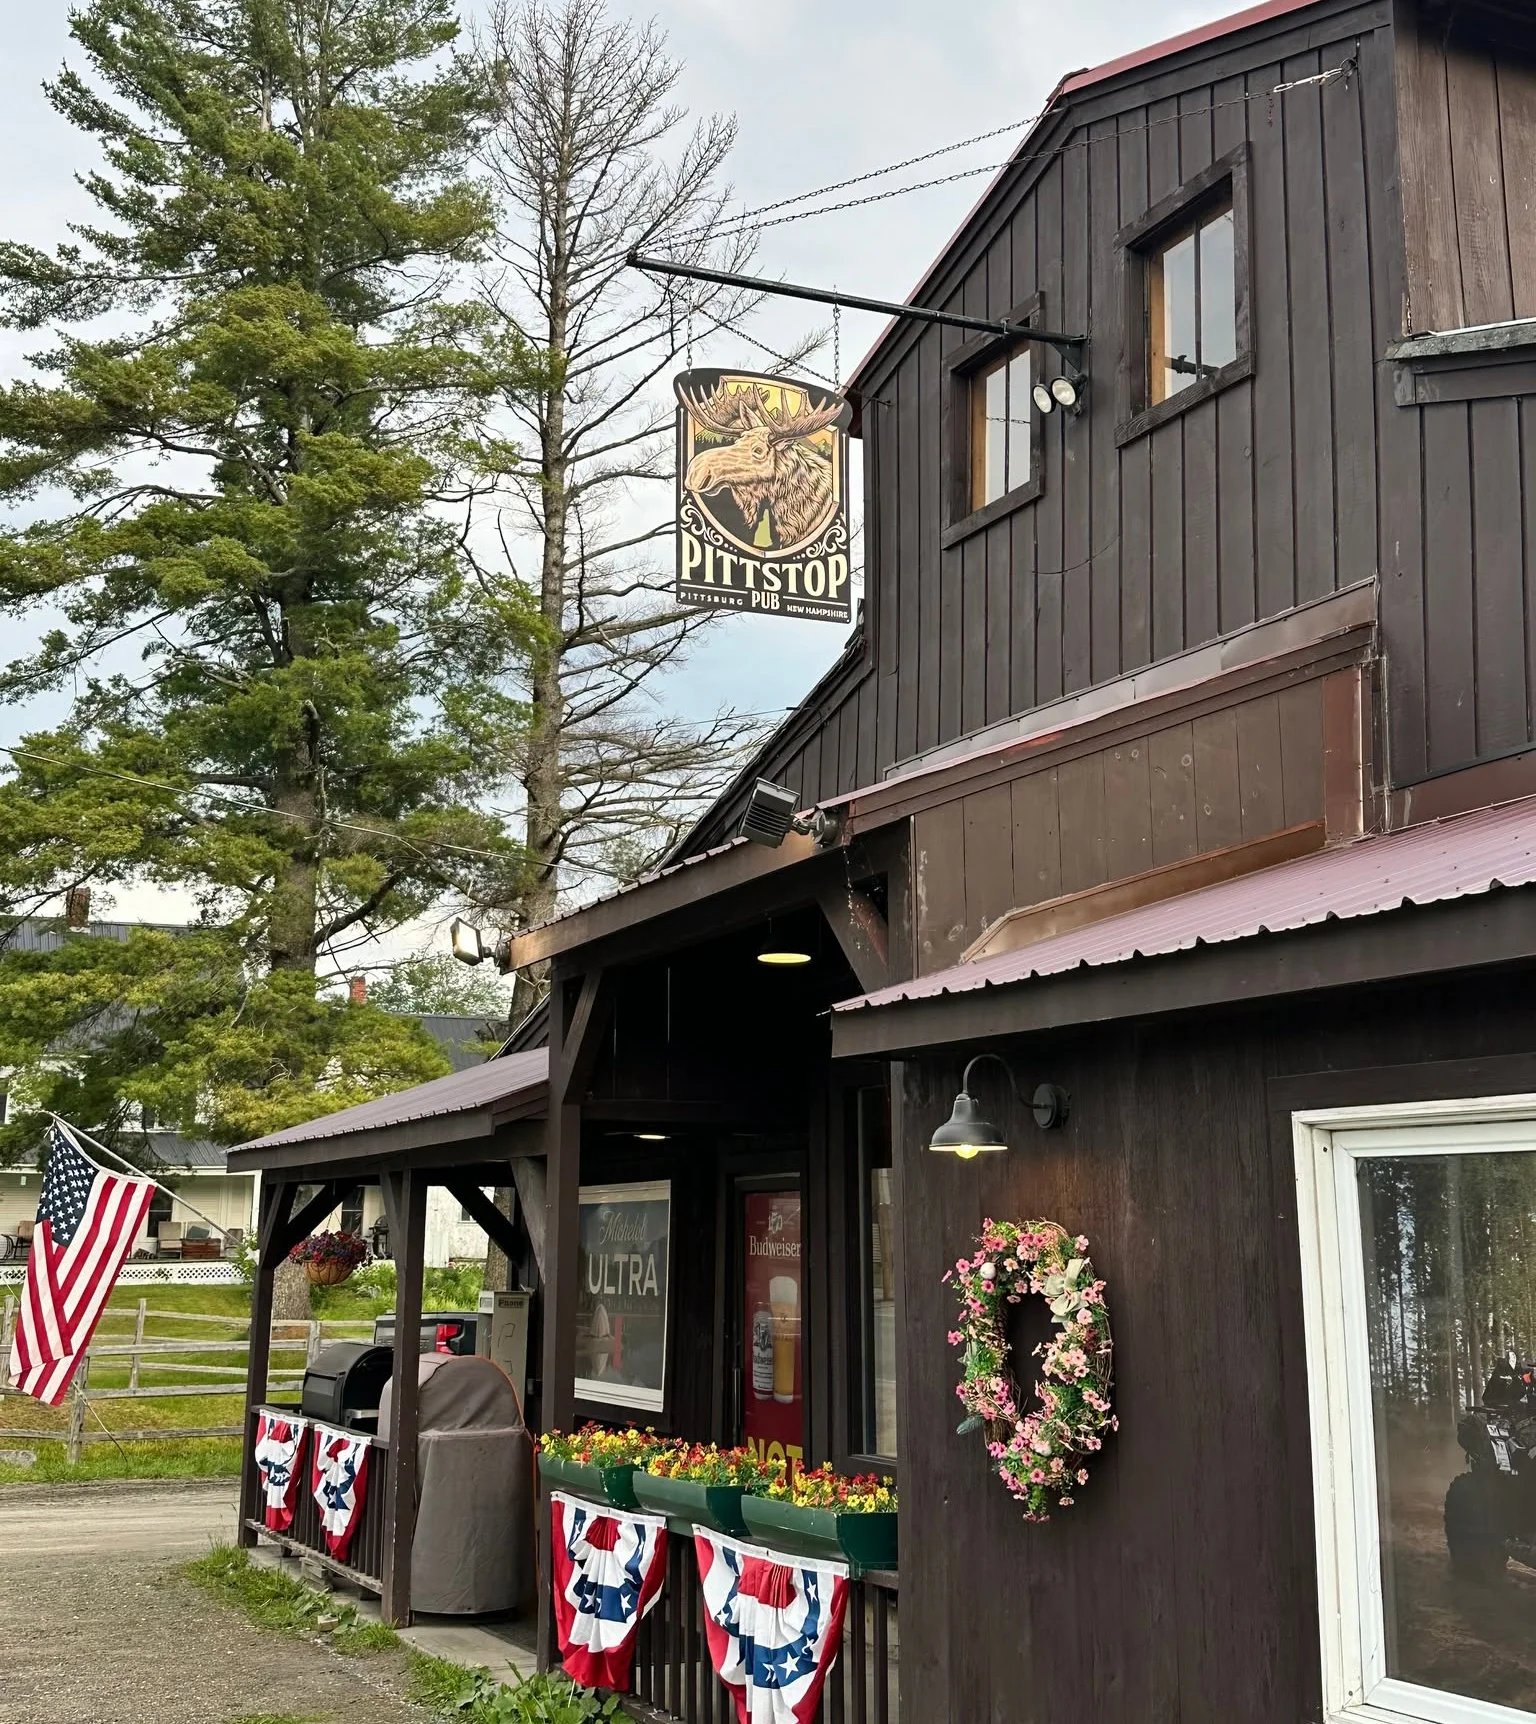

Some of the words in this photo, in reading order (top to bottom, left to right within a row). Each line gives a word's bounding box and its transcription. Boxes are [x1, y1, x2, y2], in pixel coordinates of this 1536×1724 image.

[681, 529, 848, 599] PITTSTOP
[680, 591, 743, 606] PITTSBURG
[751, 590, 781, 610] PUB
[787, 604, 805, 614] NEW
[805, 608, 848, 619] HAMPSHIRE
[749, 1235, 801, 1257] Budweiser
[588, 1253, 659, 1296] ULTRA
[498, 1299, 524, 1308] Phone
